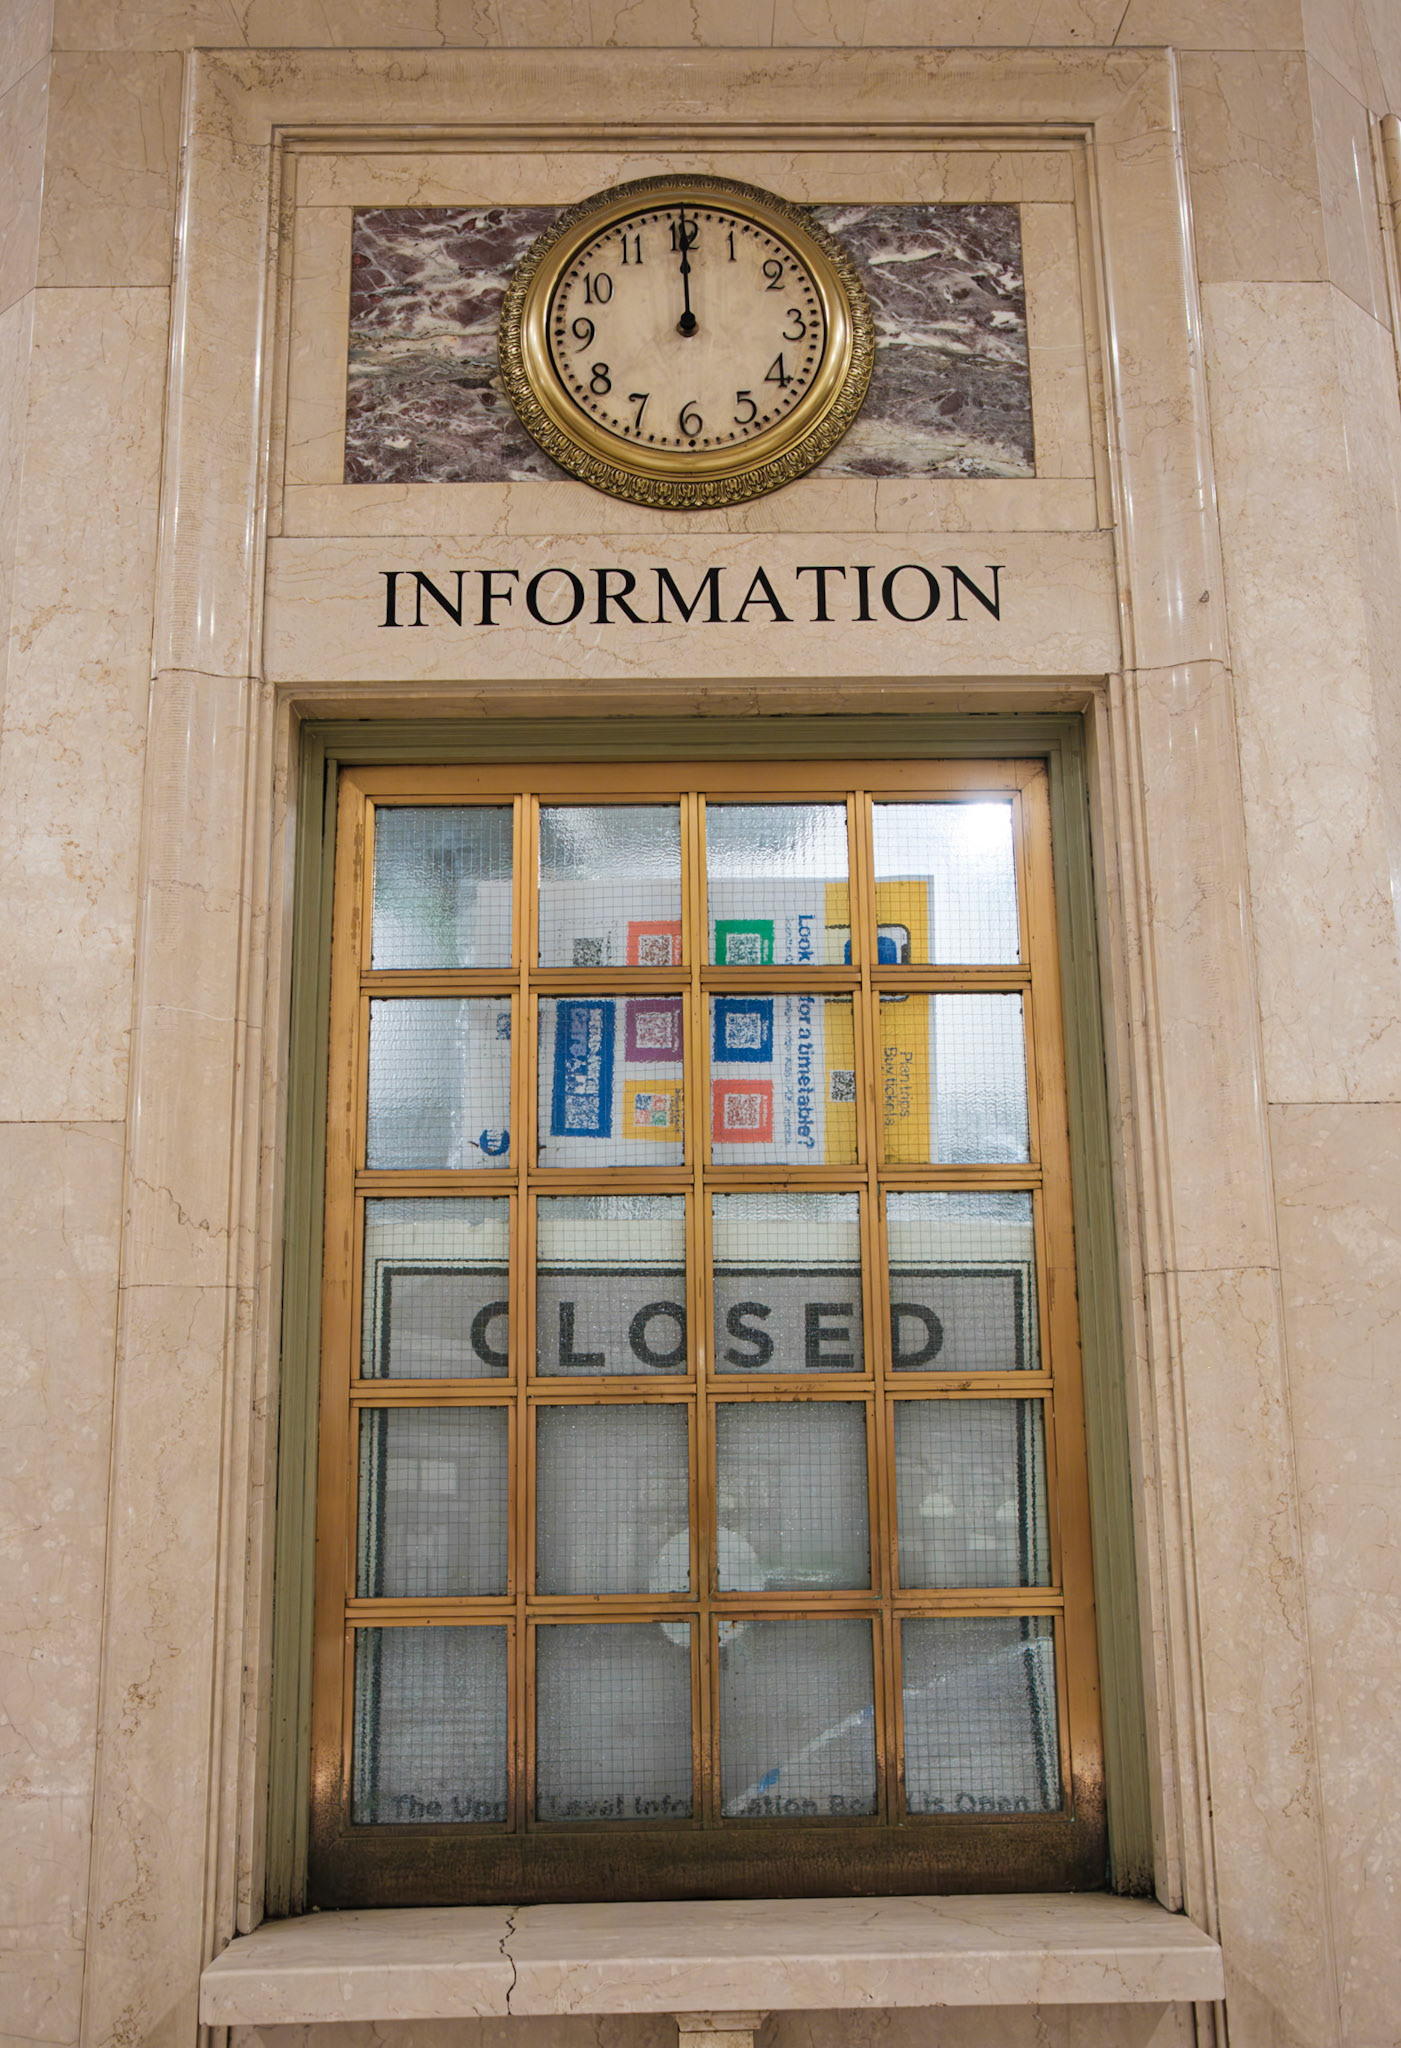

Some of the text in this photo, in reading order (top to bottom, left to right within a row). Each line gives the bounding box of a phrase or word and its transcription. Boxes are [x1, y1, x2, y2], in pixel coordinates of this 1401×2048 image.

[621, 233, 644, 265] 11
[670, 219, 700, 252] 12
[727, 230, 737, 262] 1
[584, 272, 614, 304] 10
[763, 259, 785, 291] 2
[572, 317, 595, 352] 9
[782, 308, 806, 341] 3
[590, 363, 612, 395] 8
[764, 352, 793, 388] 4
[629, 392, 649, 429] 7
[679, 400, 703, 437] 6
[734, 390, 757, 424] 5
[377, 563, 1006, 628] INFORMATION
[798, 996, 816, 1024] for
[798, 1028, 812, 1040] a
[797, 1043, 816, 1149] timetable?
[470, 1301, 944, 1368] CLOSED
